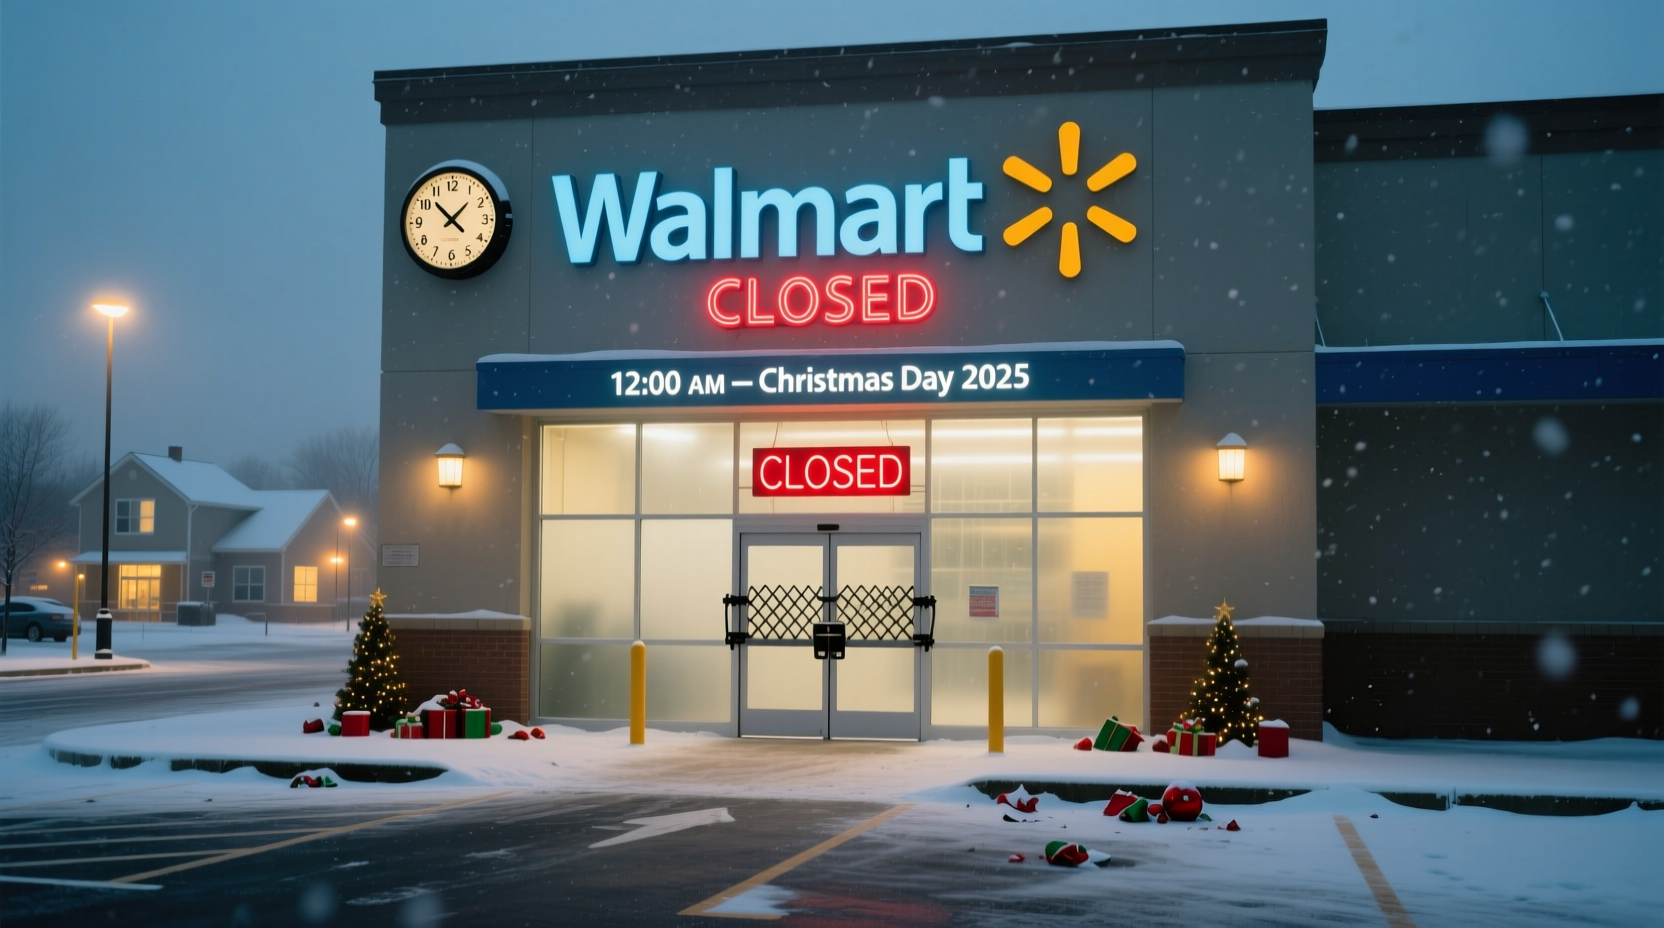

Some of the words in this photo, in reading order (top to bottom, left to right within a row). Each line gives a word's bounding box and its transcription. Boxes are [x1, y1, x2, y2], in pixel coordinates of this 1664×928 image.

[432, 185, 440, 197] 11
[446, 180, 459, 192] 12
[420, 199, 431, 211] 10
[477, 197, 484, 208] 2
[551, 157, 985, 264] Walmart
[415, 217, 423, 229] 9
[481, 214, 489, 225] 3
[420, 234, 428, 246] 8
[475, 233, 483, 242] 4
[433, 245, 439, 258] 7
[448, 249, 456, 261] 6
[465, 245, 472, 257] 5
[707, 273, 936, 327] CLOSED
[610, 370, 681, 396] 12:00
[687, 374, 725, 395] AM
[758, 366, 894, 393] Christmas
[901, 365, 955, 397] Day
[961, 363, 1030, 390] 2025
[760, 454, 902, 490] CLOSED
